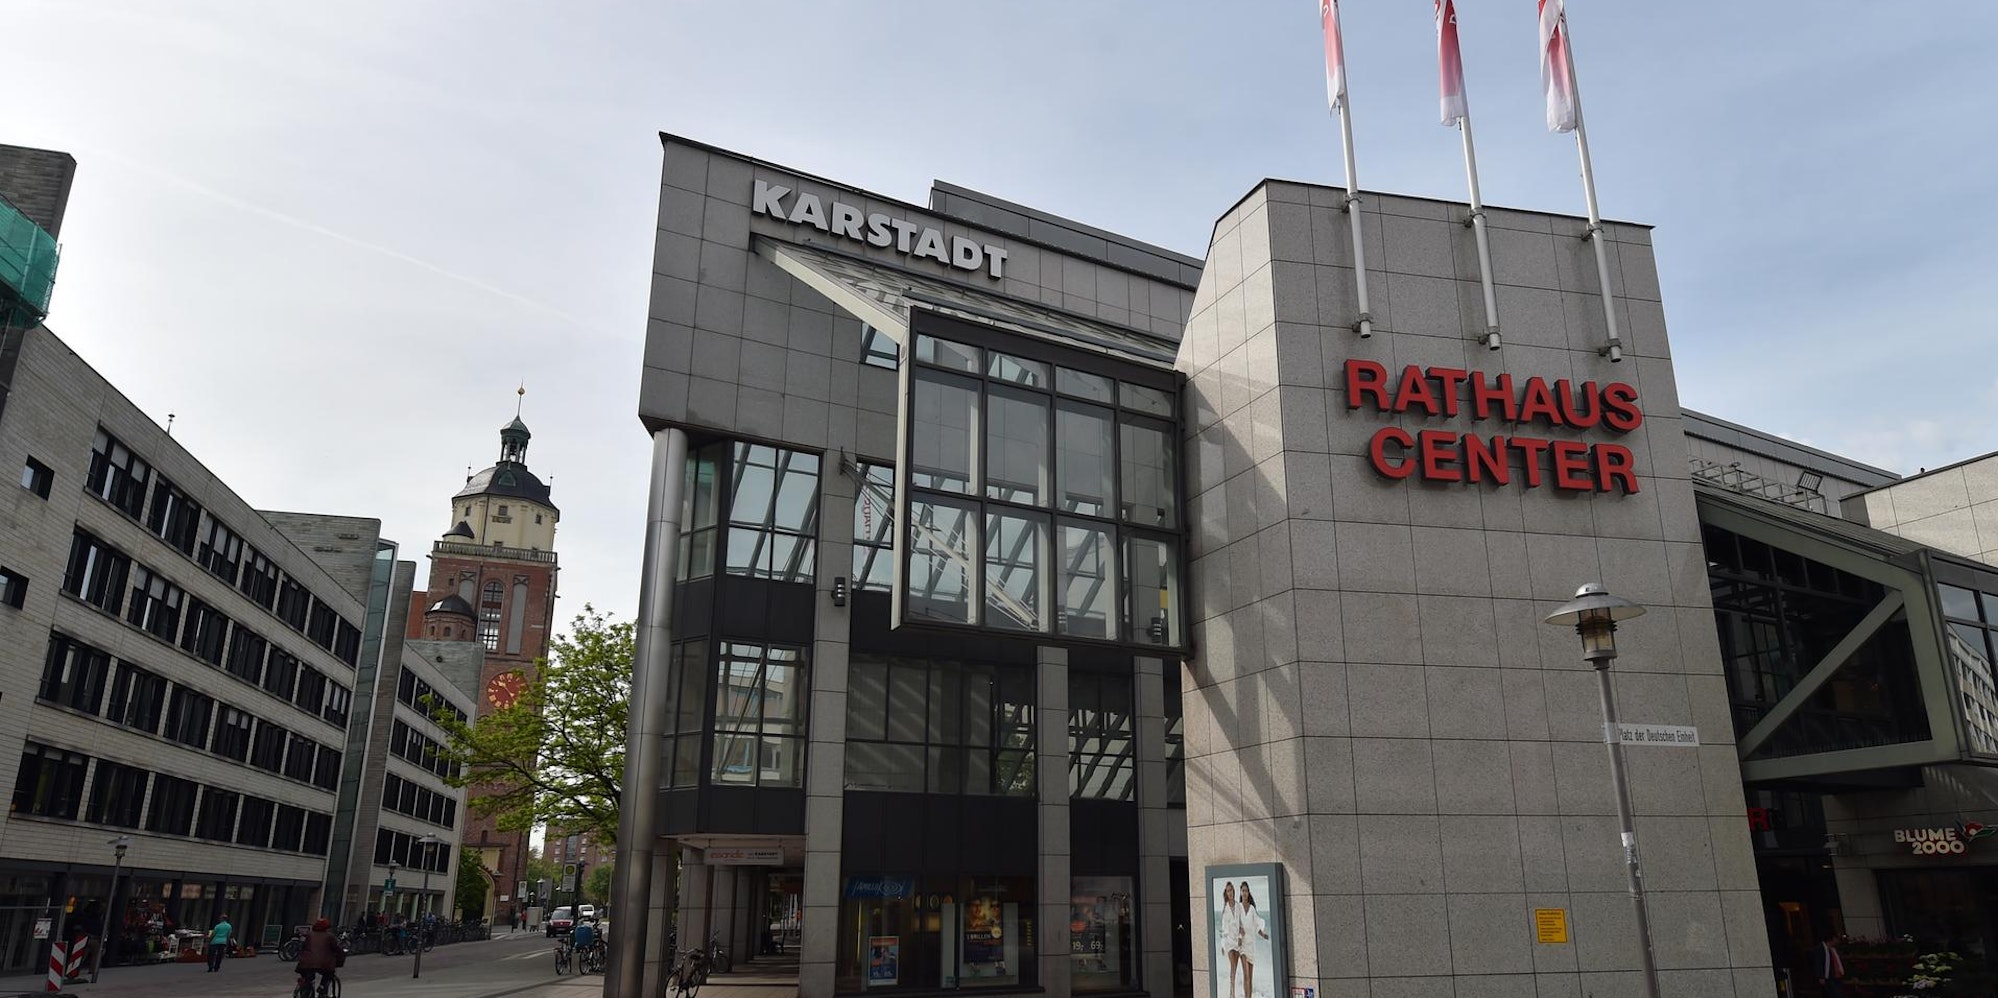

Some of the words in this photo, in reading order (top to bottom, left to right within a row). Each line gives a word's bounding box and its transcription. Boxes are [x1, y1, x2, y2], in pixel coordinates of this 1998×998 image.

[752, 179, 1008, 280] KARSTADT
[1344, 359, 1643, 433] RATHAUS
[1370, 426, 1640, 494] CENTER
[1635, 728, 1645, 742] der
[1646, 728, 1676, 743] Deutschen
[1676, 729, 1696, 743] Einheit
[1893, 827, 1957, 843] BLUME
[1911, 840, 1965, 855] 2000
